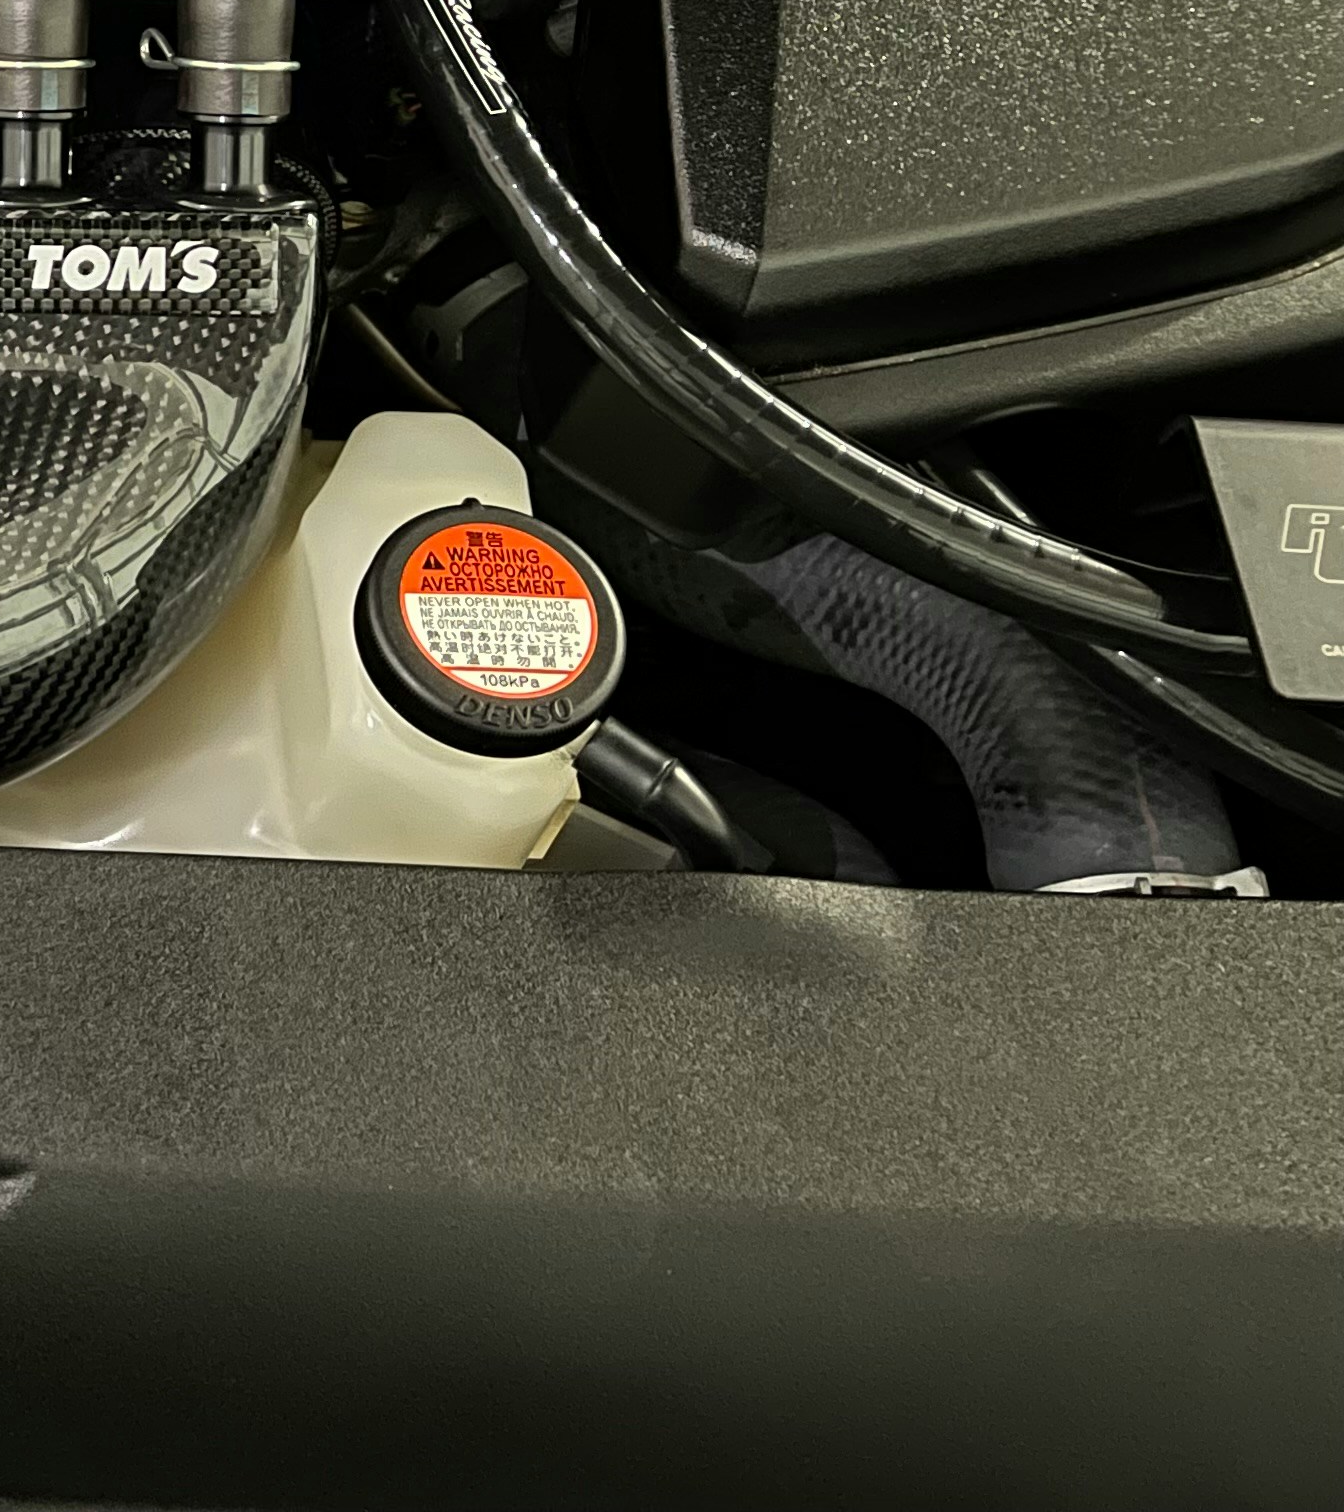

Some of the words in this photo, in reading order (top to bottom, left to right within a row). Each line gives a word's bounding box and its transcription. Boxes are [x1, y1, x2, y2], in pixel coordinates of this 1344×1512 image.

[27, 240, 220, 294] TOM'S
[446, 546, 540, 565] WARNING
[449, 562, 554, 580] ОСТОРОЖНО
[420, 576, 566, 596] AVERTISSEMENT
[418, 596, 462, 607] NEVER
[464, 596, 500, 608] OPEN
[503, 598, 541, 610] WHEN
[419, 607, 434, 618] NE
[437, 607, 479, 619] JAMAIS
[481, 608, 524, 619] OUVRIR
[480, 674, 540, 689] 108kPa
[453, 694, 575, 729] DENSO
